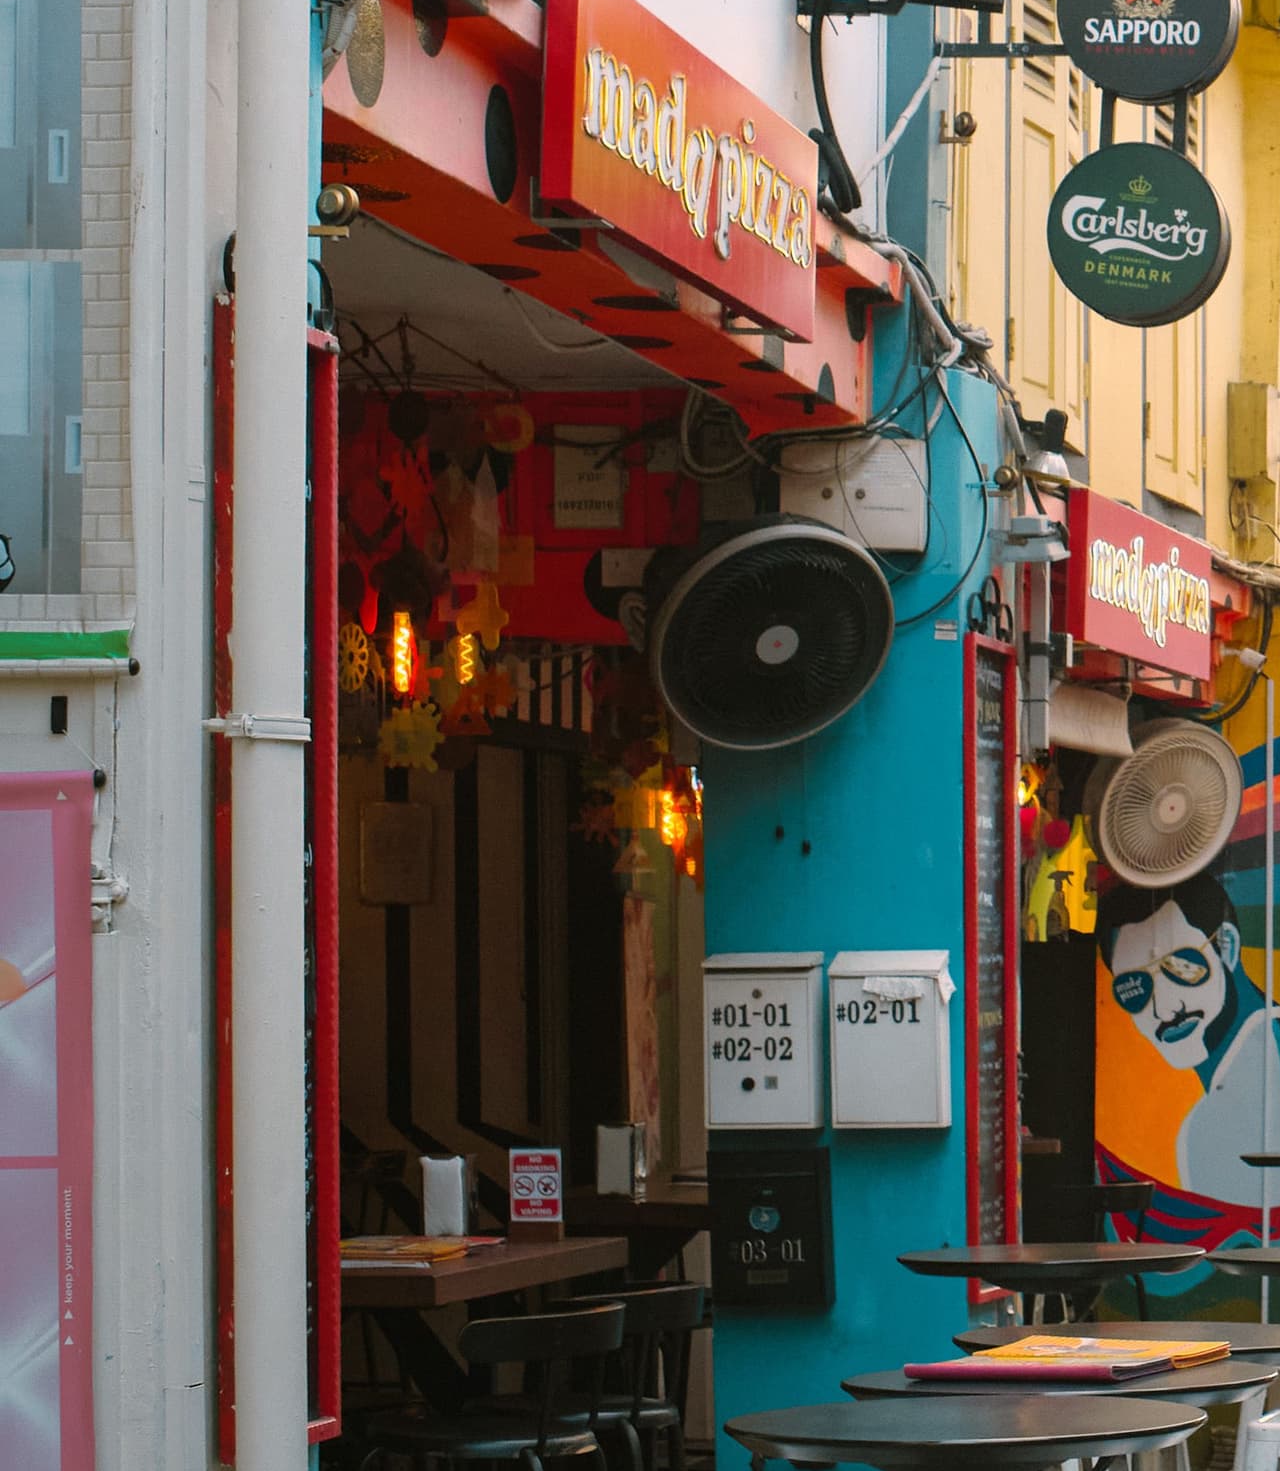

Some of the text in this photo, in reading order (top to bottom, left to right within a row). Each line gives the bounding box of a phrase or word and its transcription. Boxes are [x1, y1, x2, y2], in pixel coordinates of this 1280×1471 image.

[1084, 18, 1200, 45] SAPPORO
[714, 119, 813, 269] pizza
[1062, 195, 1208, 261] Carlsberg
[1084, 261, 1172, 283] DENMARK
[712, 1004, 791, 1027] #01-01
[836, 1000, 920, 1024] #02-01
[712, 1036, 792, 1061] #02-02
[64, 1244, 74, 1270] your
[64, 1273, 73, 1304] keep
